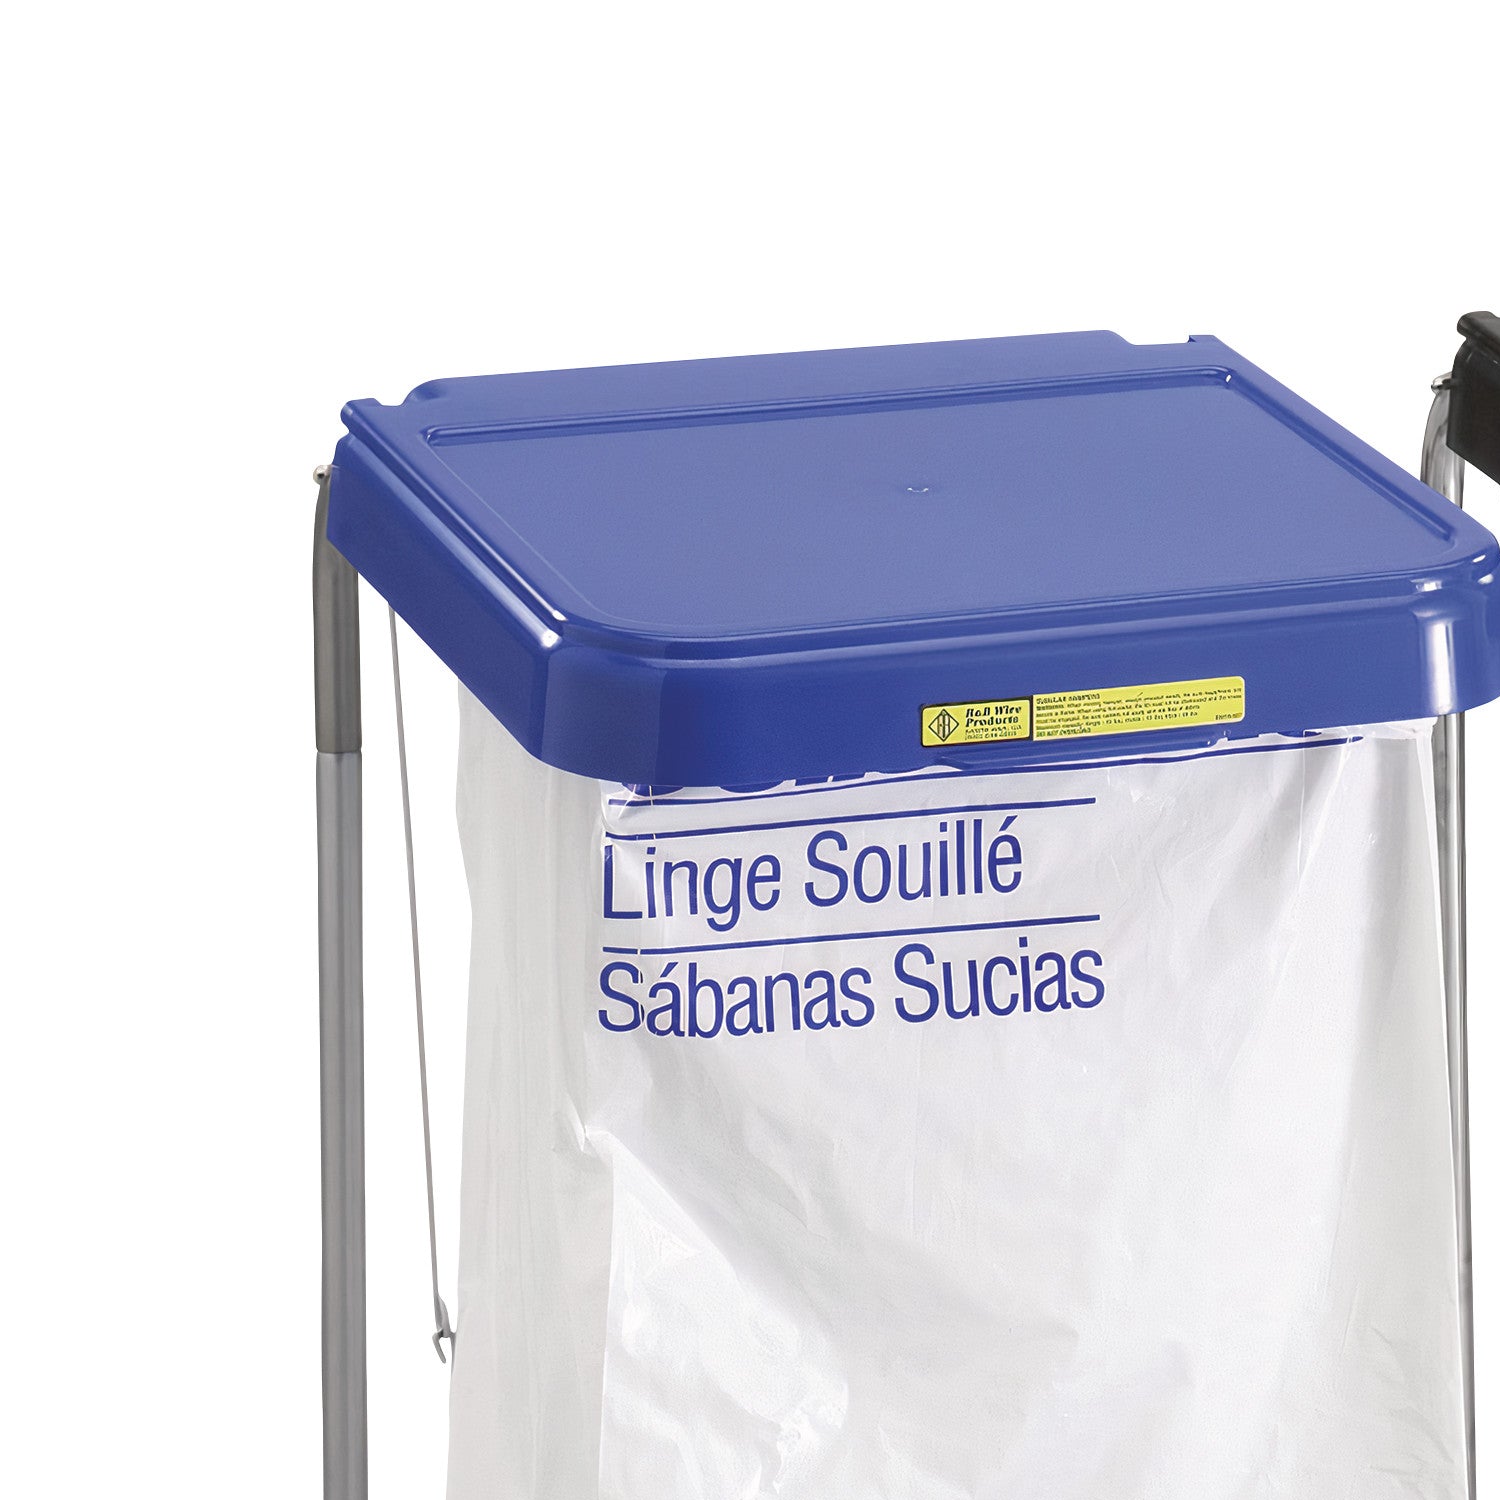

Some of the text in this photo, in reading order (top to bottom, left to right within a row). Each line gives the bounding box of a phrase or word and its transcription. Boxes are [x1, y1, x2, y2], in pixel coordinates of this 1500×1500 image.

[603, 815, 1022, 932] Linge Souillé
[598, 936, 1105, 1039] Sábanas Sucias
